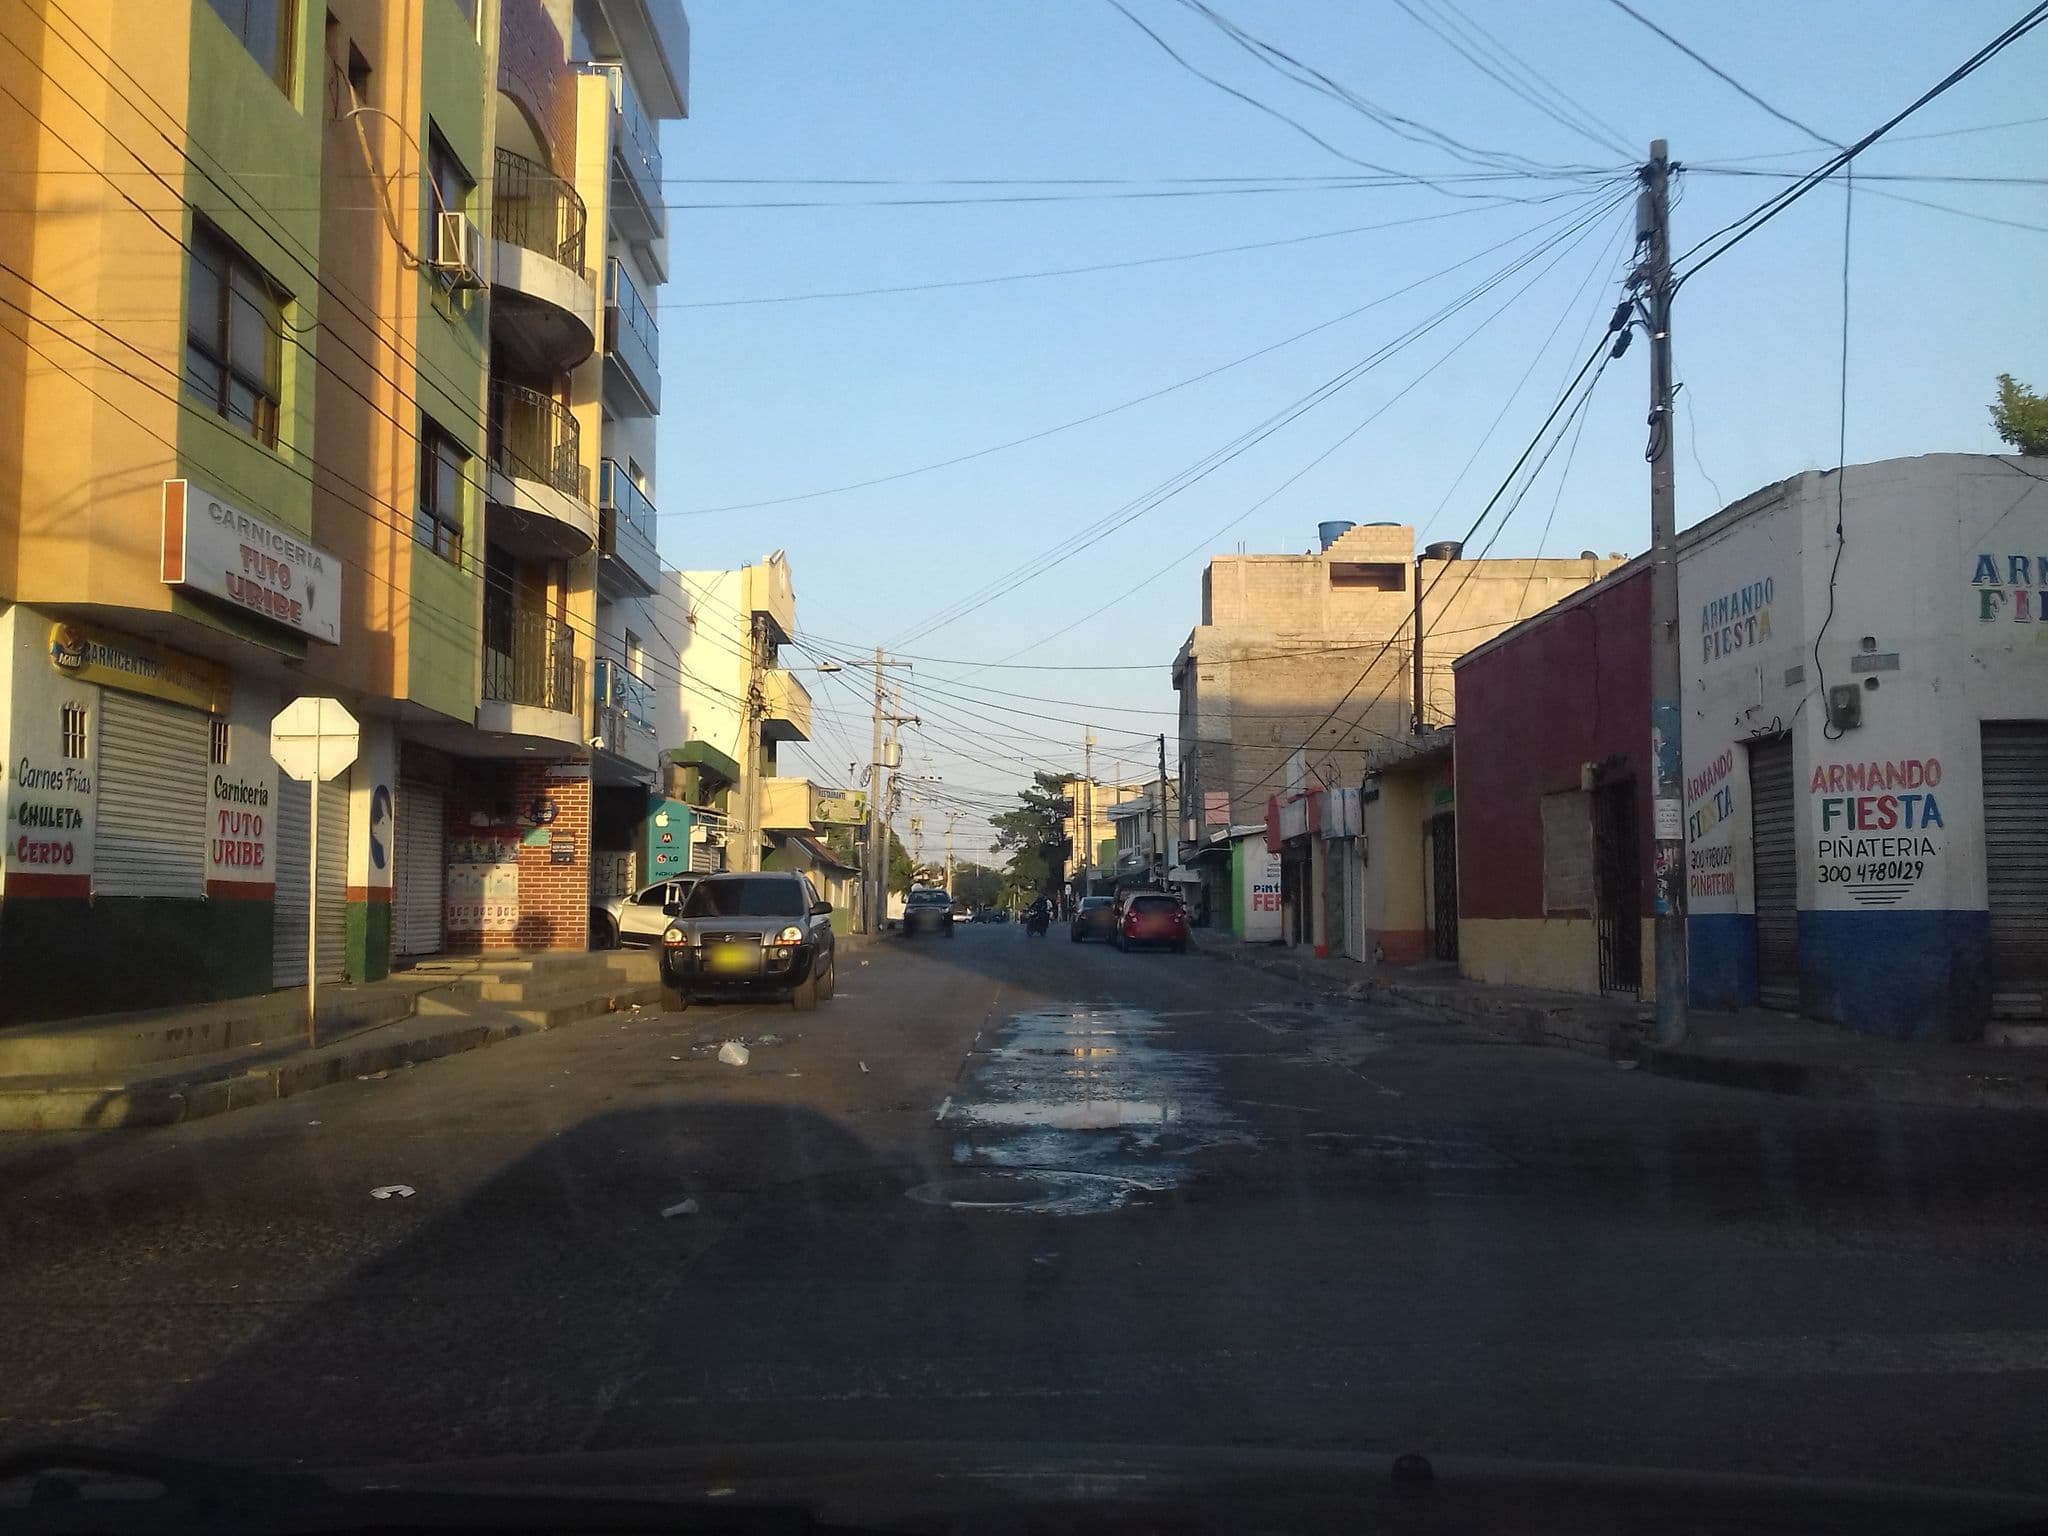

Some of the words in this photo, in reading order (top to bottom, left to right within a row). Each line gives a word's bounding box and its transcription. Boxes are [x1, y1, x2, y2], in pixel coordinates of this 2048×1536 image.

[208, 502, 324, 574] CARNICERIA
[240, 543, 292, 591] TUTO
[225, 570, 302, 625] URIBE
[1702, 577, 1773, 633] ARMANDO
[1703, 608, 1772, 664] FIESTA
[19, 757, 63, 790] Carnes
[1687, 748, 1733, 807] ARMANDO
[1810, 758, 1942, 794] ARMANDO
[19, 801, 83, 829] CHULETA
[219, 810, 262, 837] TUTO
[1822, 793, 1943, 832] FIESTA
[17, 835, 74, 865] CERDO
[213, 839, 265, 866] URIBE
[1819, 835, 1936, 858] PIÑATERIA
[1690, 870, 1735, 897] PIÑATERIA
[1818, 865, 1851, 882] 300
[1857, 861, 1924, 882] 4780129
